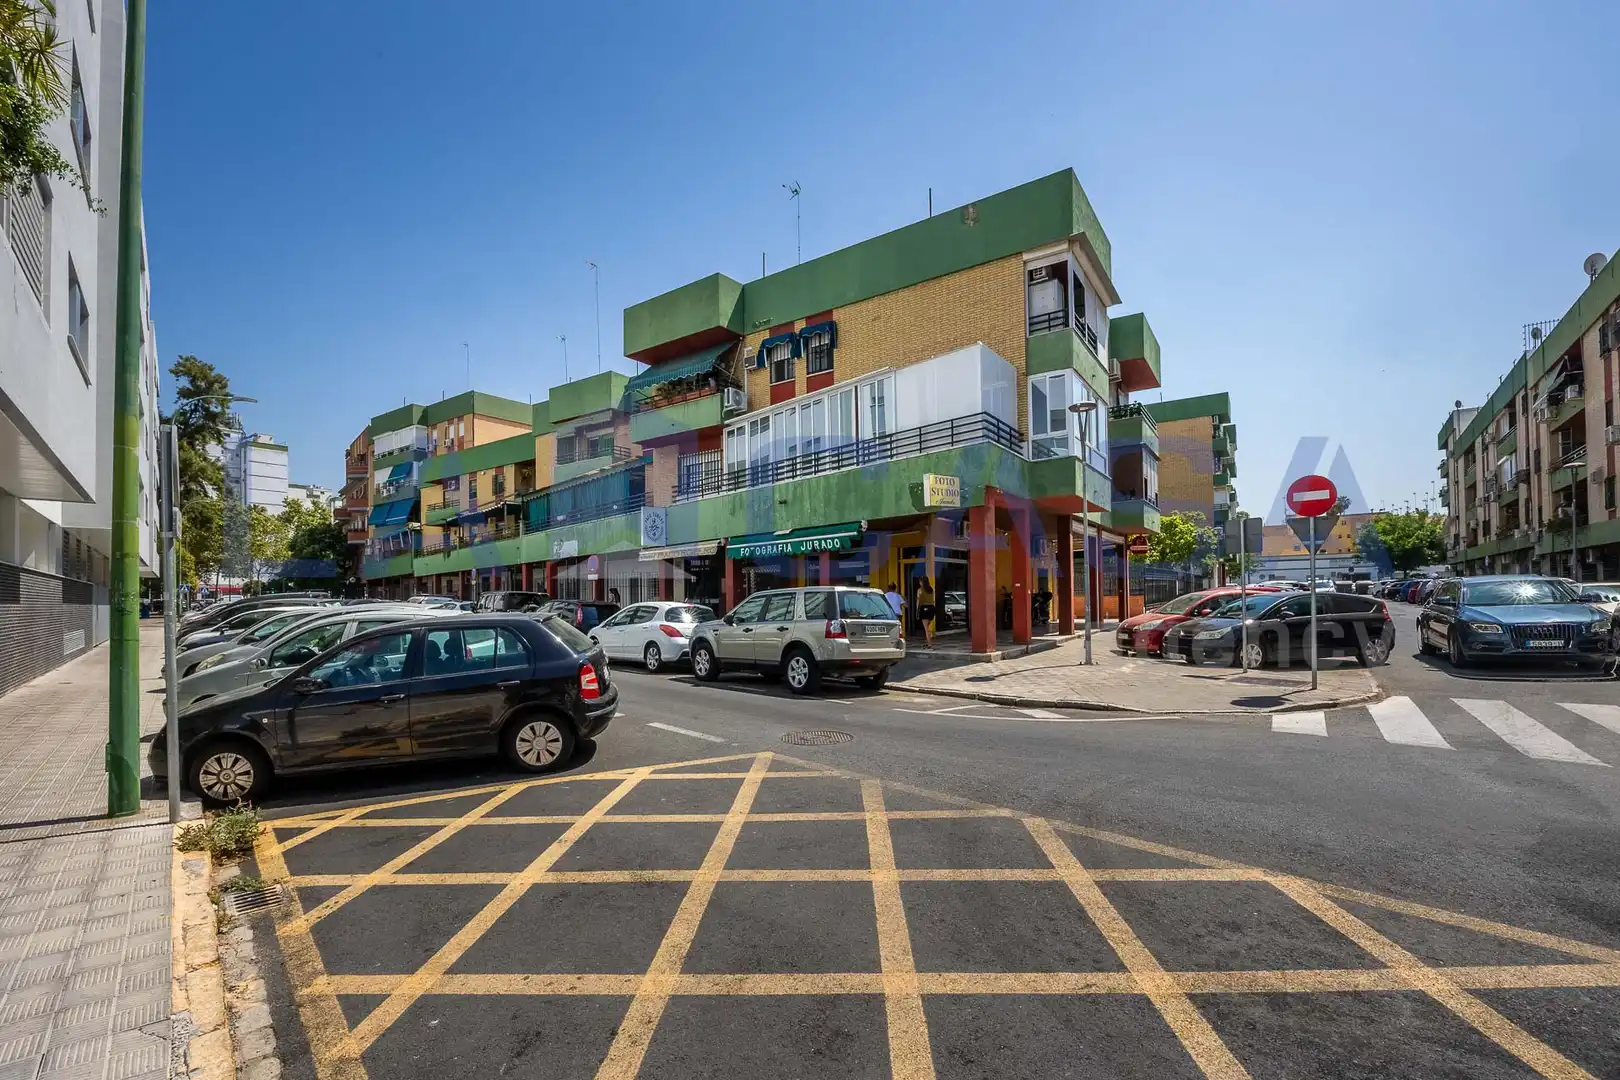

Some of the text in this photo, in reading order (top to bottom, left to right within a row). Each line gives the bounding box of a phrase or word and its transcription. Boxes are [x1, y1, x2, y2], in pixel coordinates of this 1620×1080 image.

[934, 476, 955, 486] FOTO
[931, 487, 959, 498] STUDIO
[800, 538, 841, 551] JURADO
